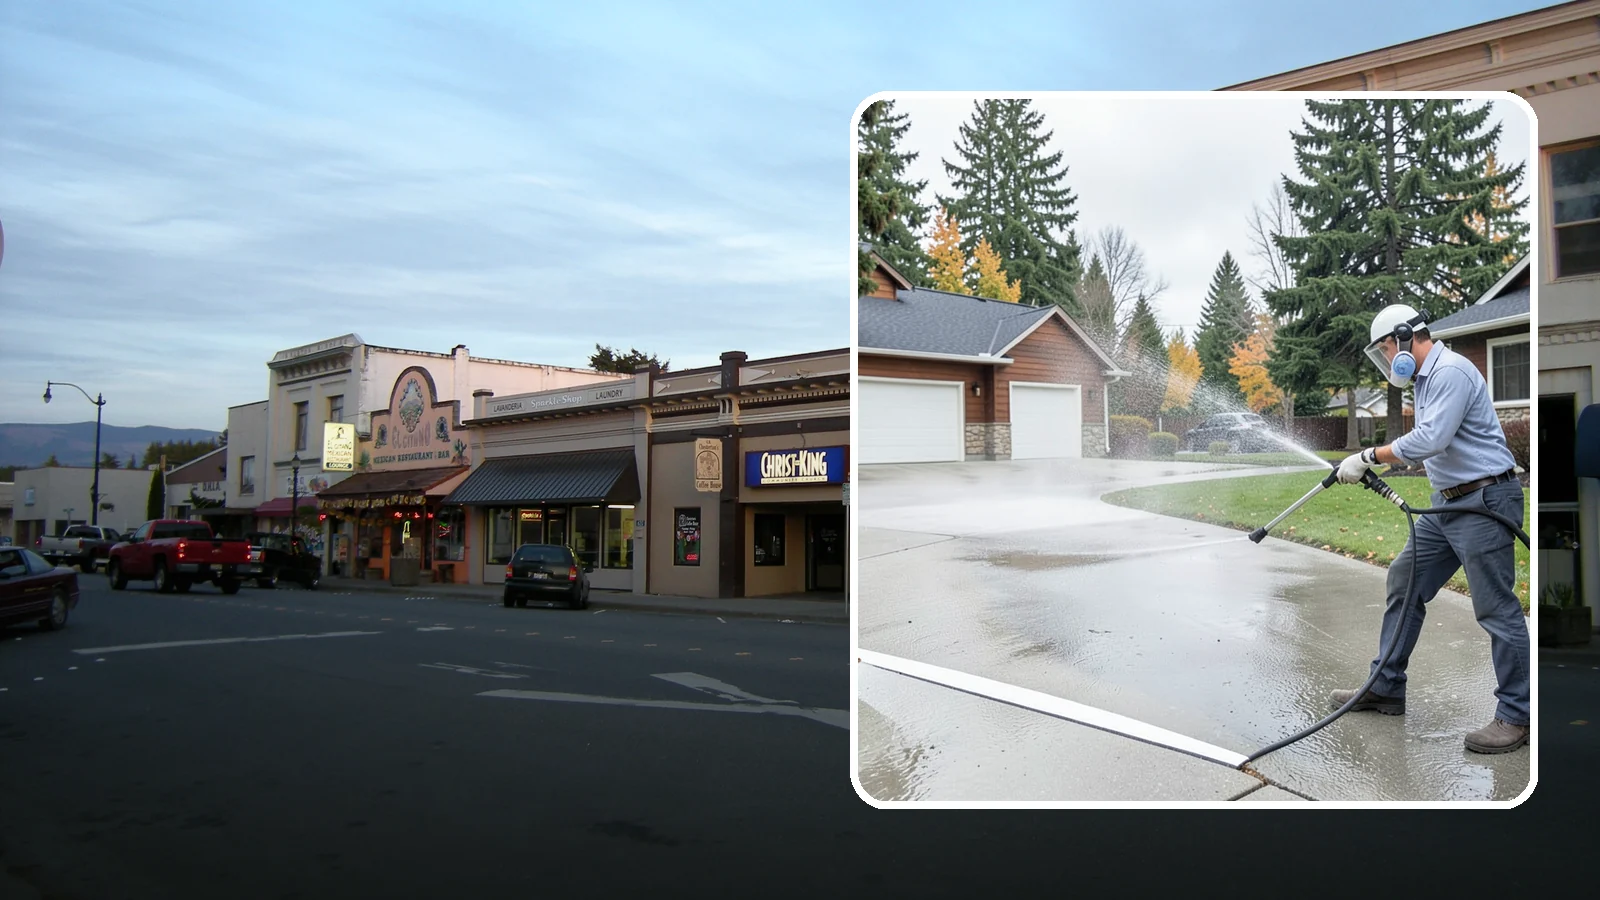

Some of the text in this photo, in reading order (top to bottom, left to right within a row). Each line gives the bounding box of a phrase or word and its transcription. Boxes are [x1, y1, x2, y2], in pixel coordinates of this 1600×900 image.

[595, 388, 624, 400] LAUNDRY
[493, 401, 523, 412] LAVANDERIA
[530, 394, 583, 409] Sparkle Shop
[373, 454, 396, 464] MEXICAN
[397, 451, 433, 462] RESTAURANT
[437, 450, 450, 459] BAR
[696, 480, 722, 488] Coffee House
